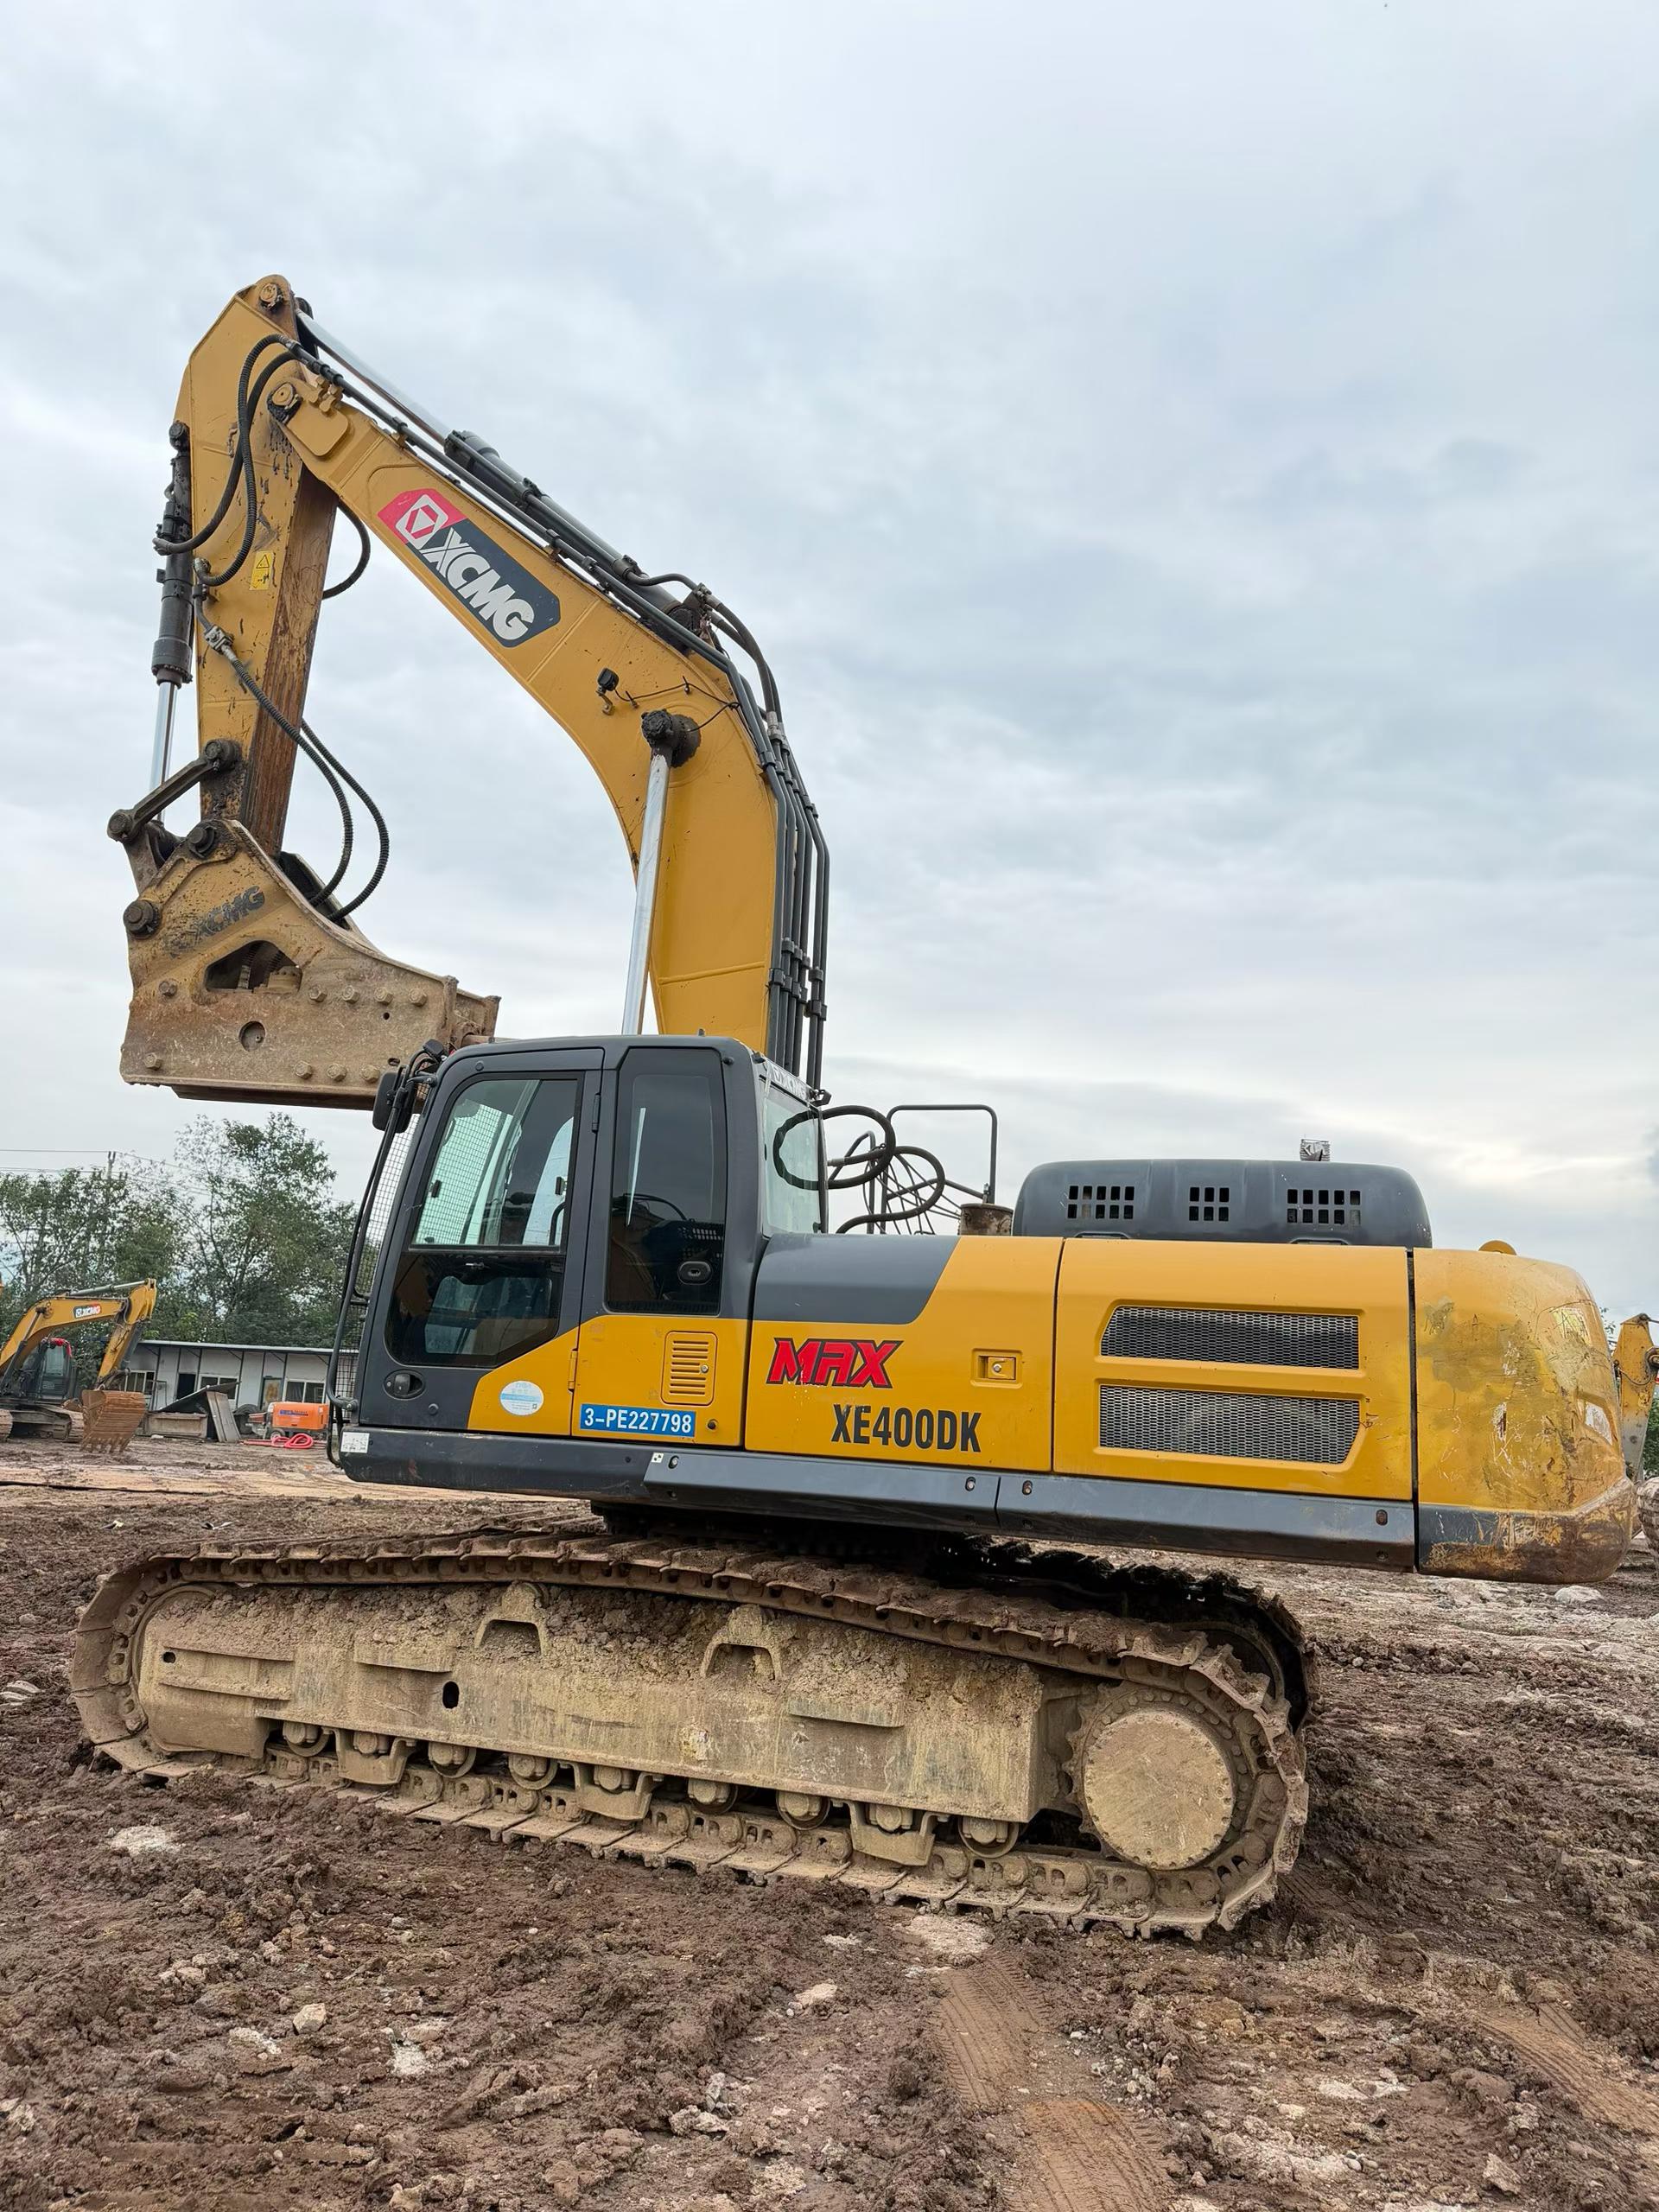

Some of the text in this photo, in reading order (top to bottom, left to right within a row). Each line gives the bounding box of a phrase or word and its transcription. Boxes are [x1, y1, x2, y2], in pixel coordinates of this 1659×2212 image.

[419, 527, 535, 641] XCMG
[766, 1337, 904, 1389] MAX
[584, 1408, 692, 1433] 3-PE227798
[830, 1403, 982, 1452] XE400DK
